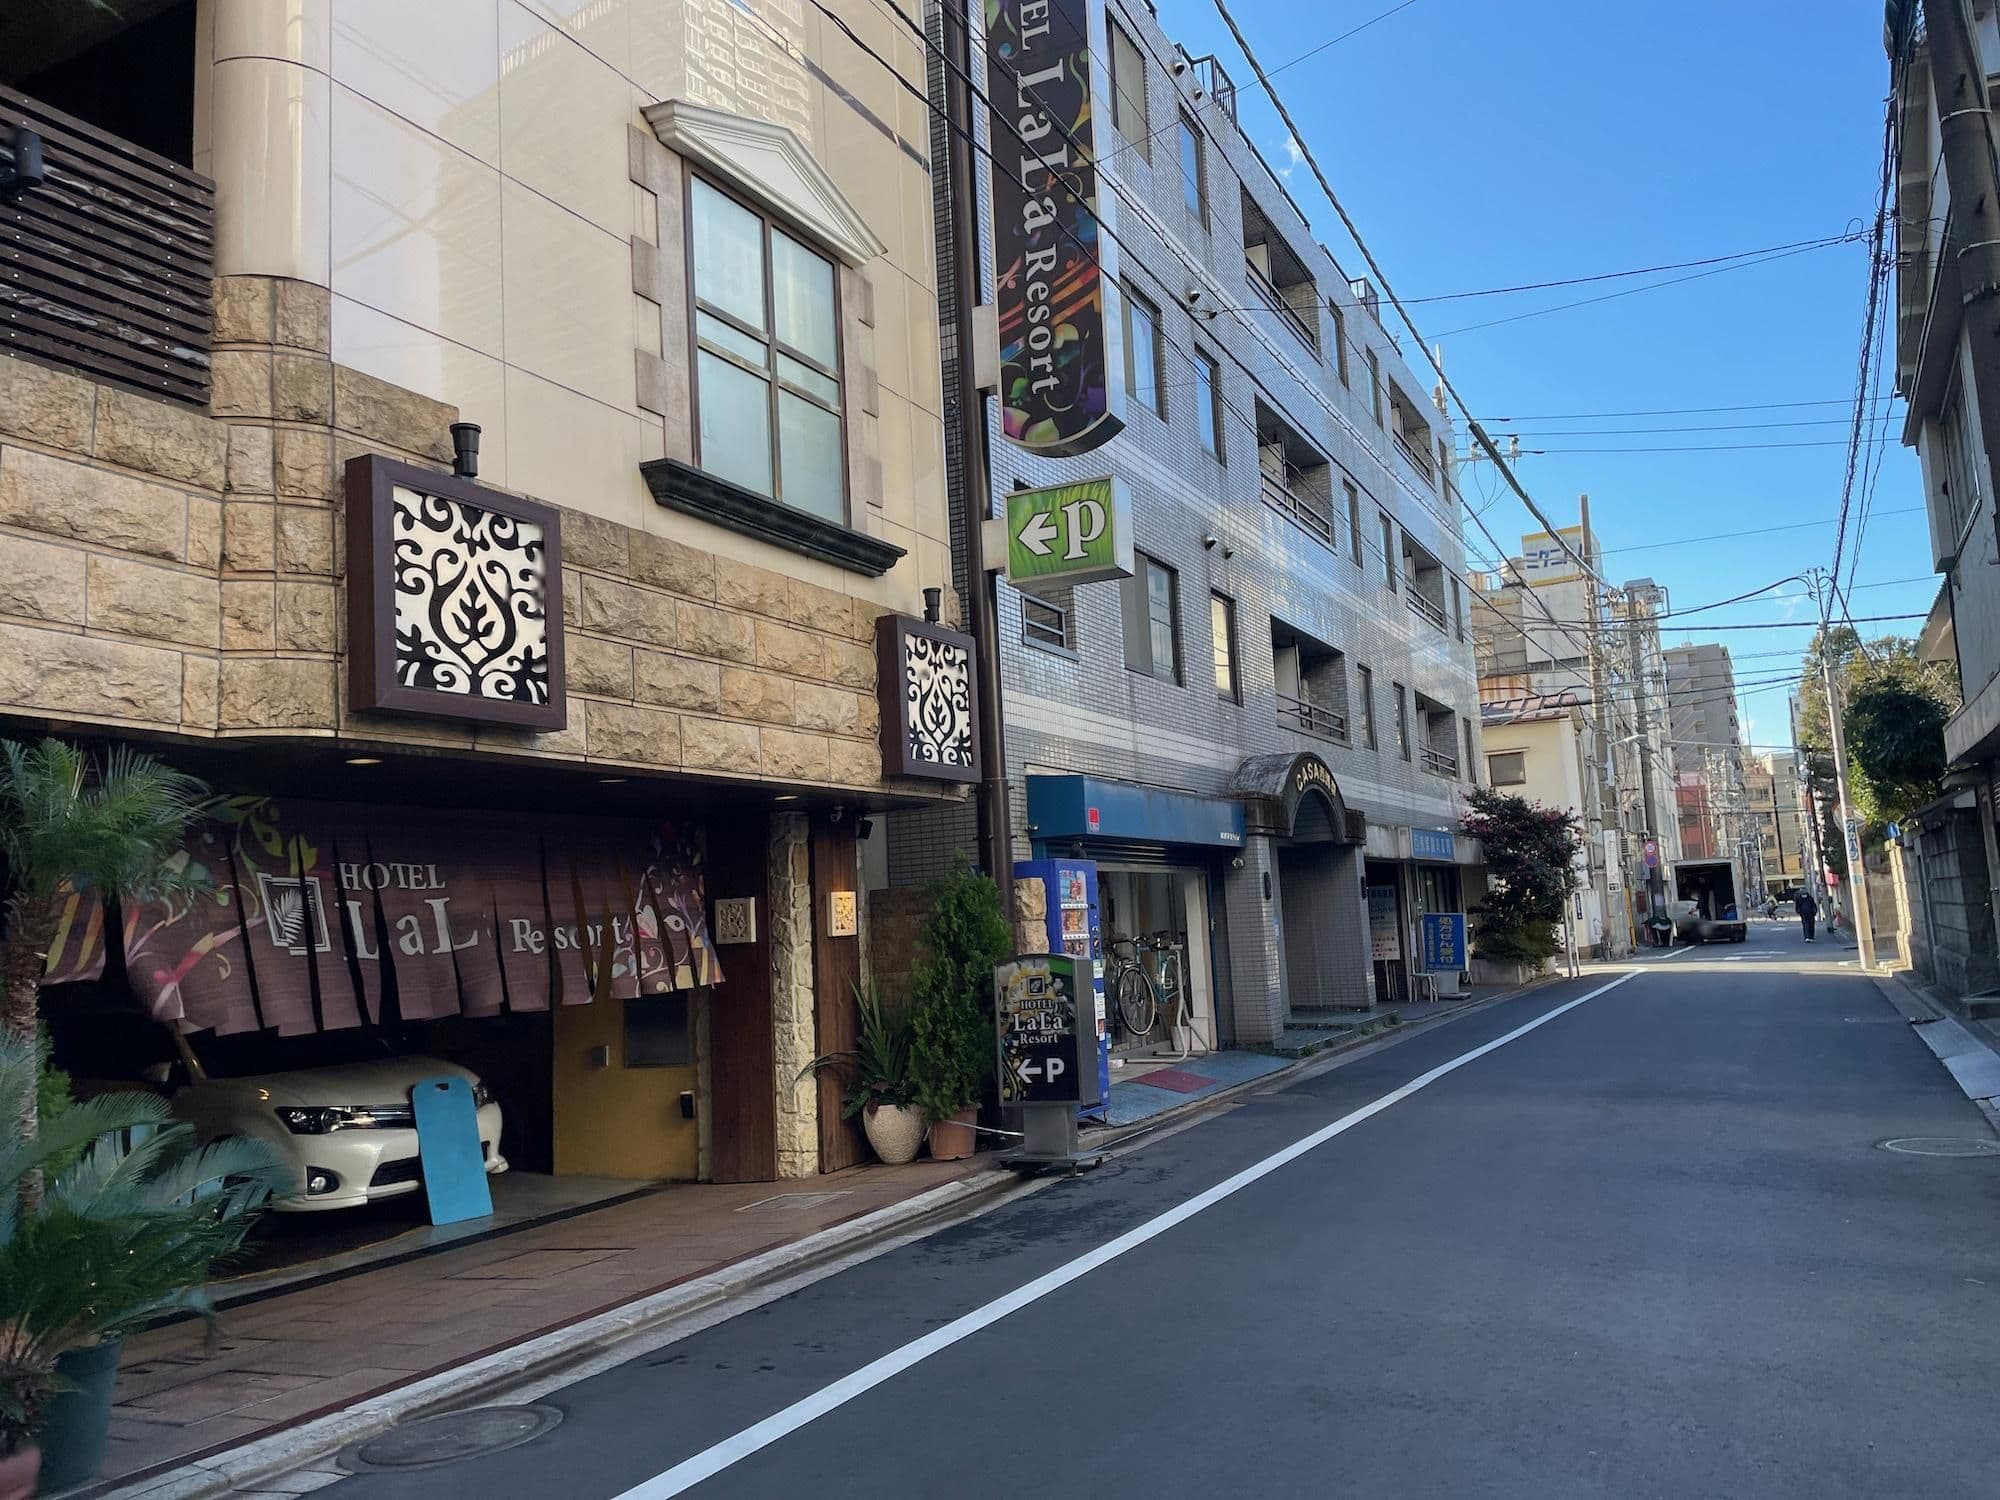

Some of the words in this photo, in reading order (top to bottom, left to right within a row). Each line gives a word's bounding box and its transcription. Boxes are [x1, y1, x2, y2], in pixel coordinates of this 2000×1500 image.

[1017, 57, 1070, 235] LaLa
[1024, 243, 1061, 395] Resort
[332, 861, 446, 891] HOTEL
[1020, 1000, 1055, 1010] HOTEL
[1013, 1012, 1063, 1032] LaLa
[1020, 1033, 1058, 1044] Resort
[1046, 1057, 1065, 1083] P
